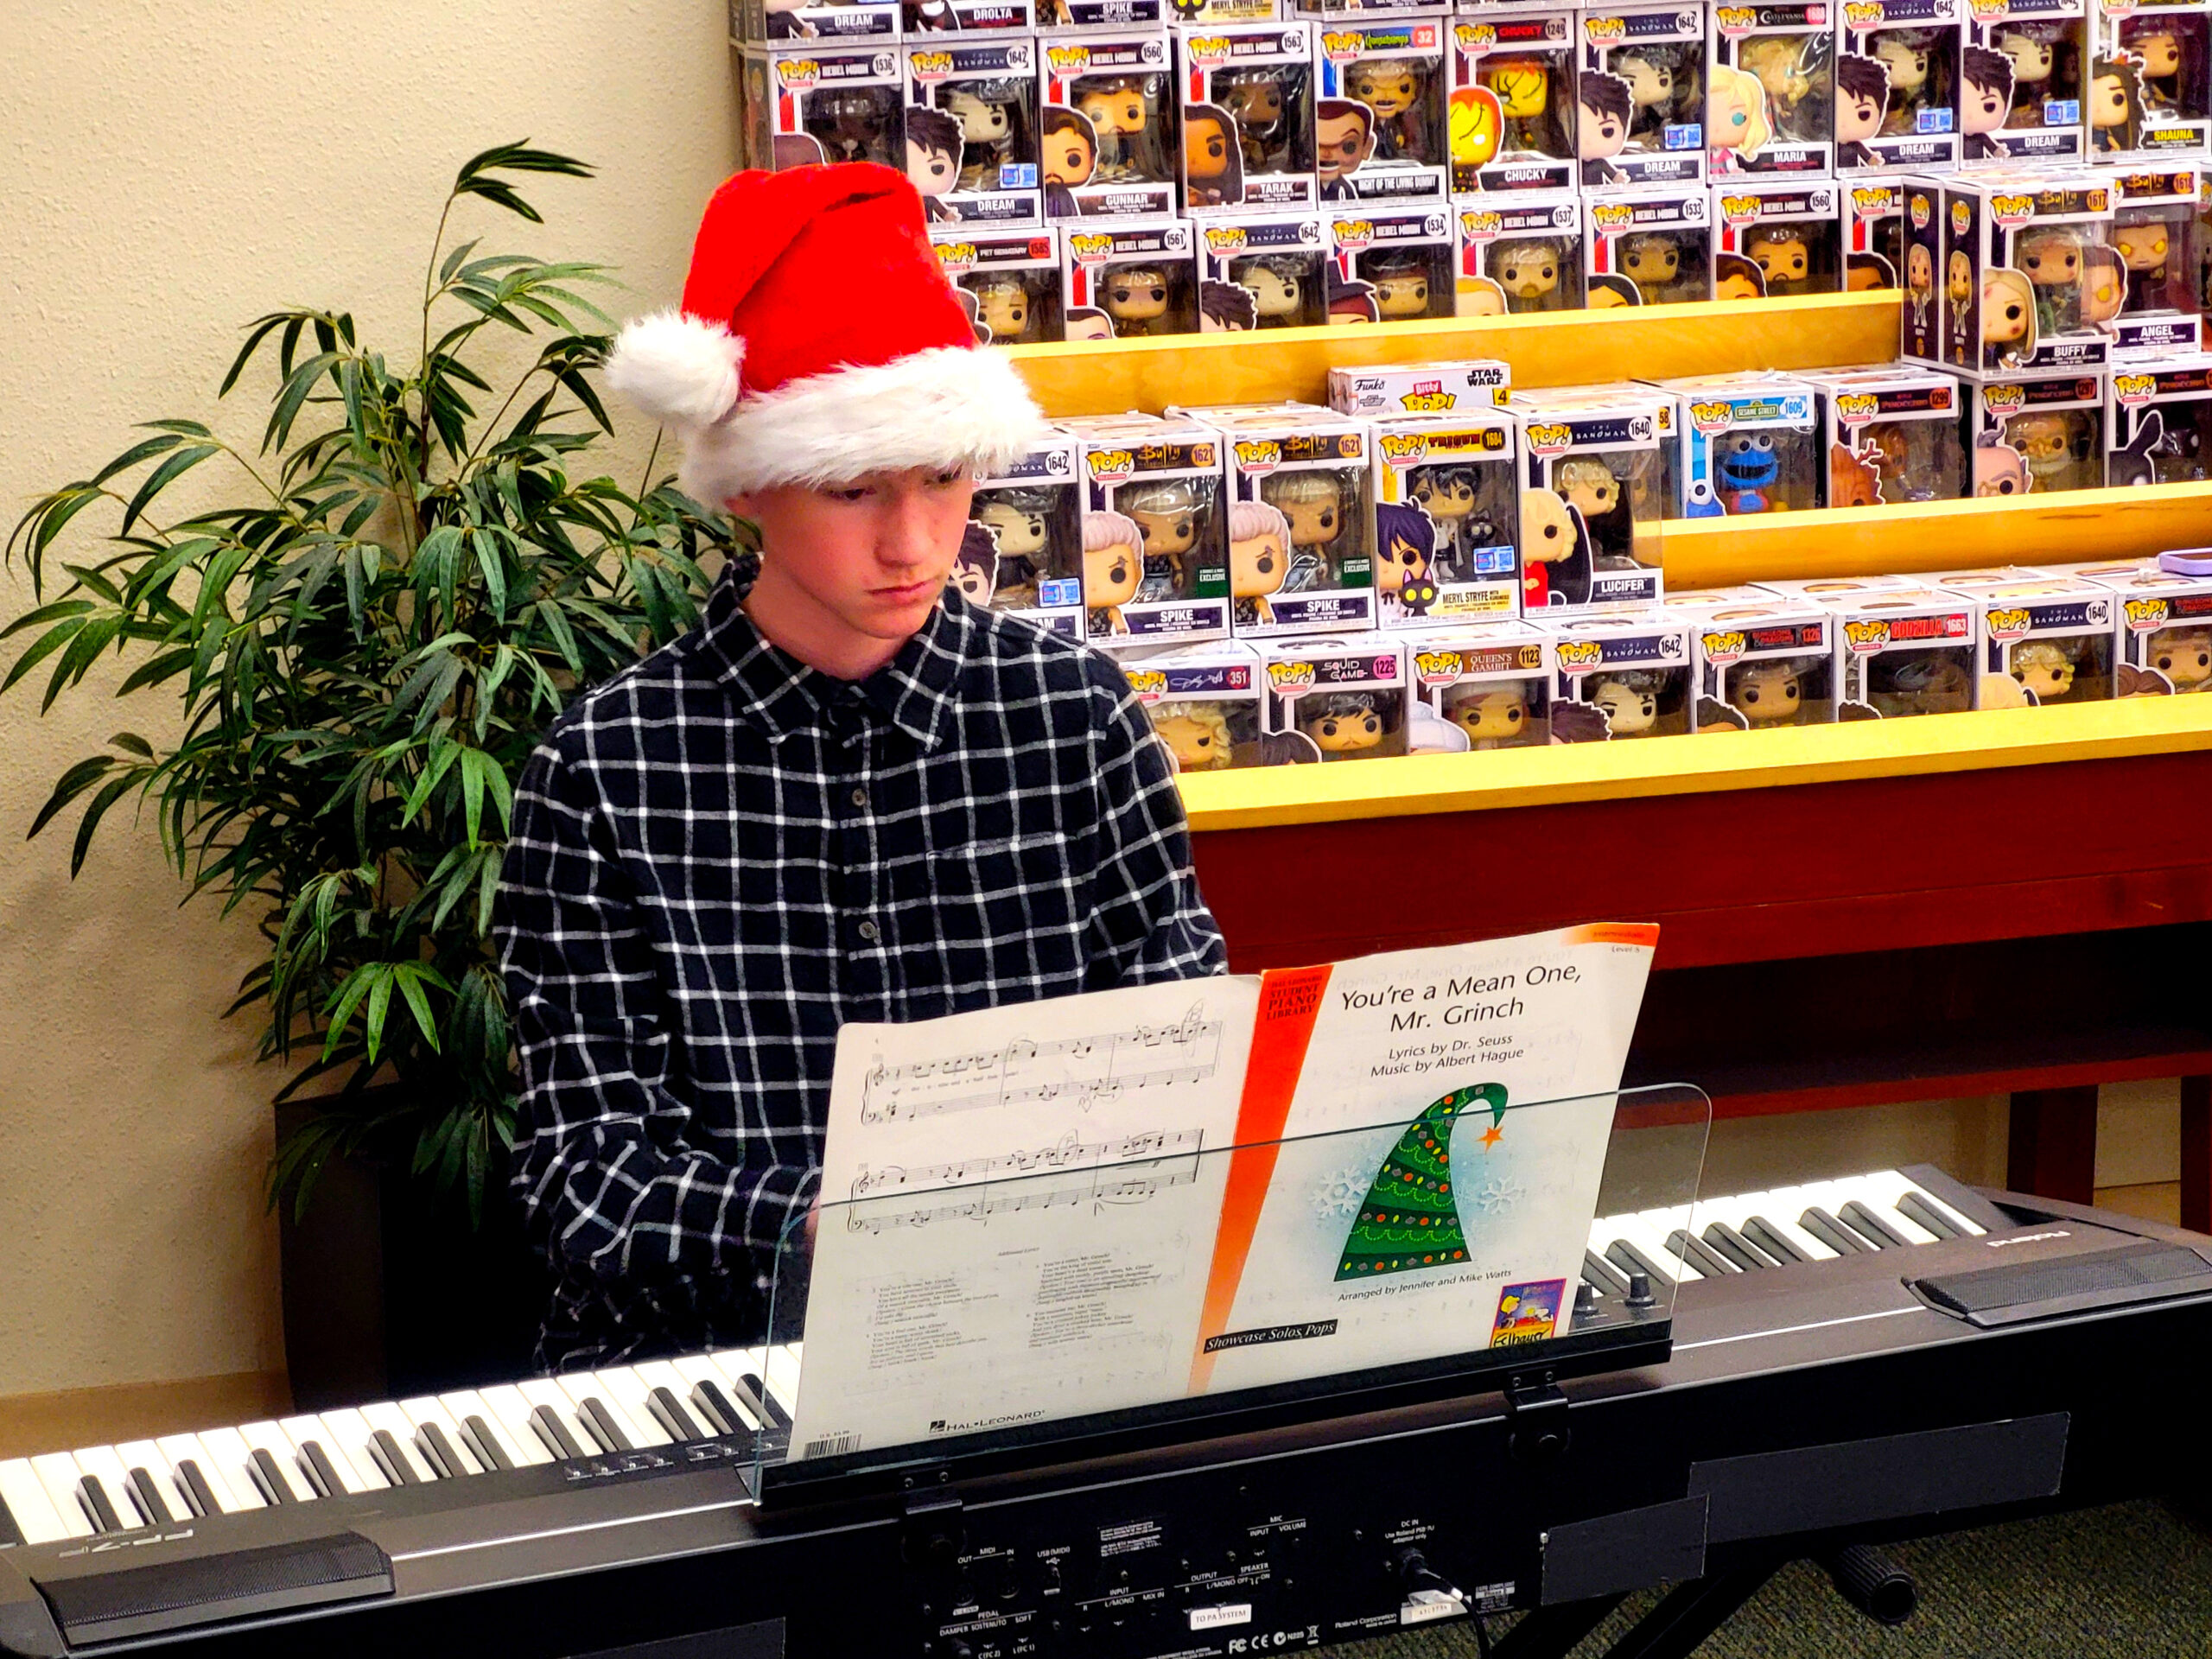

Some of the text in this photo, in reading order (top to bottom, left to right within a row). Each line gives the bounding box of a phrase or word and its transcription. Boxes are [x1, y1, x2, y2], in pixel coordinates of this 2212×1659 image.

[834, 14, 874, 28] DREAM
[973, 8, 1014, 21] DROLTA
[1716, 6, 1756, 29] POP!
[1844, 2, 1884, 26] POP!
[1455, 23, 1496, 48] POP!
[1498, 25, 1542, 38] CHUCKY
[1547, 22, 1566, 36] 1249
[1585, 17, 1625, 41] POP!
[1283, 35, 1303, 48] 1563
[1321, 31, 1363, 56] POP!
[1417, 30, 1433, 44] 32
[1142, 47, 1162, 59] 1560
[1187, 36, 1231, 60] POP!
[910, 52, 953, 77] POP!
[1008, 51, 1028, 64] 1642
[1046, 46, 1090, 71] POP!
[776, 60, 819, 84] POP!
[874, 58, 895, 72] 1536
[2024, 136, 2061, 148] DREAM
[2153, 129, 2195, 142] SHAUNA
[1898, 143, 1935, 156] DREAM
[1774, 151, 1807, 163] MARIA
[1643, 161, 1681, 174] DREAM
[1504, 168, 1548, 182] CHUCKY
[1259, 182, 1294, 194] TARAK
[976, 199, 1016, 213] DREAM
[1105, 193, 1149, 207] GUNNAR
[1811, 194, 1831, 208] 1560
[1852, 188, 1892, 212] POP!
[1684, 202, 1703, 216] 1533
[1721, 196, 1762, 219] POP!
[1989, 197, 2033, 220] POP!
[1554, 210, 1573, 224] 1537
[1592, 206, 1633, 230] POP!
[1300, 225, 1319, 239] 1642
[1427, 219, 1446, 232] 1534
[1460, 213, 1502, 237] POP!
[1166, 233, 1185, 245] 1561
[1205, 227, 1247, 251] POP!
[1332, 220, 1373, 245] POP!
[1070, 233, 1113, 258] POP!
[2140, 326, 2175, 338] ANGEL
[2053, 345, 2088, 357] BUFFY
[1470, 368, 1503, 379] STAR
[1355, 378, 1387, 392] Funko
[1414, 380, 1441, 396] Bitty
[1467, 376, 1503, 387] WARS
[2113, 375, 2156, 397] POP!
[1497, 390, 1508, 404] 4
[1982, 385, 2024, 407] POP!
[1783, 401, 1803, 415] 1609
[1835, 394, 1878, 416] POP!
[1689, 402, 1732, 426] POP!
[1576, 429, 1627, 440] SANDMAN
[1630, 420, 1651, 435] 1640
[1526, 423, 1572, 448] POP!
[1233, 441, 1280, 464] POP!
[1339, 440, 1361, 454] 1621
[1380, 434, 1427, 458] POP!
[1047, 454, 1068, 470] 1642
[1085, 450, 1134, 474] POP!
[1192, 449, 1215, 464] 1621
[1600, 580, 1645, 593] LUCIFER
[1442, 593, 1464, 604] MERYL
[1465, 590, 1488, 602] STRYFE
[1306, 600, 1340, 613] SPIKE
[2087, 605, 2107, 620] 1640
[2122, 599, 2167, 624] POP!
[1160, 609, 1194, 622] SPIKE
[2034, 613, 2084, 625] SANDMAN
[1890, 620, 1943, 639] GODZILLA
[1946, 616, 1967, 633] 1663
[1986, 611, 2031, 637] POP!
[1843, 621, 1889, 647] POP!
[1660, 639, 1681, 655] 1642
[1700, 632, 1745, 658] POP!
[1469, 654, 1513, 664] QUEEN'S
[1520, 650, 1541, 664] 1123
[1554, 640, 1603, 667] POP!
[1605, 647, 1657, 658] SANDMAN
[1321, 660, 1361, 672] SQUID
[1375, 657, 1396, 673] 1225
[1414, 650, 1463, 677] POP!
[1471, 662, 1513, 673] GAMBIT
[1230, 671, 1248, 685] 351
[1267, 662, 1316, 687] POP!
[1331, 670, 1369, 681] GAME
[1342, 963, 1583, 1011] You're a Mean One,
[1268, 993, 1318, 1011] PIANO
[1267, 1004, 1315, 1020] LIBRARY
[1390, 997, 1524, 1033] Mr. Grinch
[1389, 1033, 1513, 1061] Lyrics by Dr. Seuss
[1370, 1046, 1524, 1078] Music by Albert Hague
[1338, 1268, 1512, 1303] Arranged by Jennifer and Mike Watts
[1206, 1322, 1335, 1351] Showcase Solos Pops
[1269, 1515, 1283, 1523] MIC
[1401, 1518, 1420, 1529] DC IN
[1249, 1528, 1270, 1537] INPUT
[1278, 1522, 1306, 1533] VOLUME
[979, 1546, 996, 1555] MIDI
[957, 1555, 973, 1565] OUT
[1240, 1562, 1270, 1574] SPEAKER
[1191, 1571, 1217, 1583] OUTPUT
[1236, 1577, 1249, 1586] OFF
[1109, 1586, 1130, 1597] INPUT
[1205, 1579, 1236, 1591] L/MONO
[1104, 1597, 1135, 1608] L/MONO
[1142, 1591, 1166, 1602] MIX IN
[977, 1610, 1000, 1620] PEDAL
[1014, 1614, 1033, 1624] SOFT
[1195, 1609, 1247, 1624] TO PA SYSTEM
[1334, 1618, 1359, 1629] Roland
[1358, 1612, 1397, 1625] Corporation
[938, 1624, 969, 1637] DAMPER
[970, 1618, 1007, 1632] SOSTENUTO
